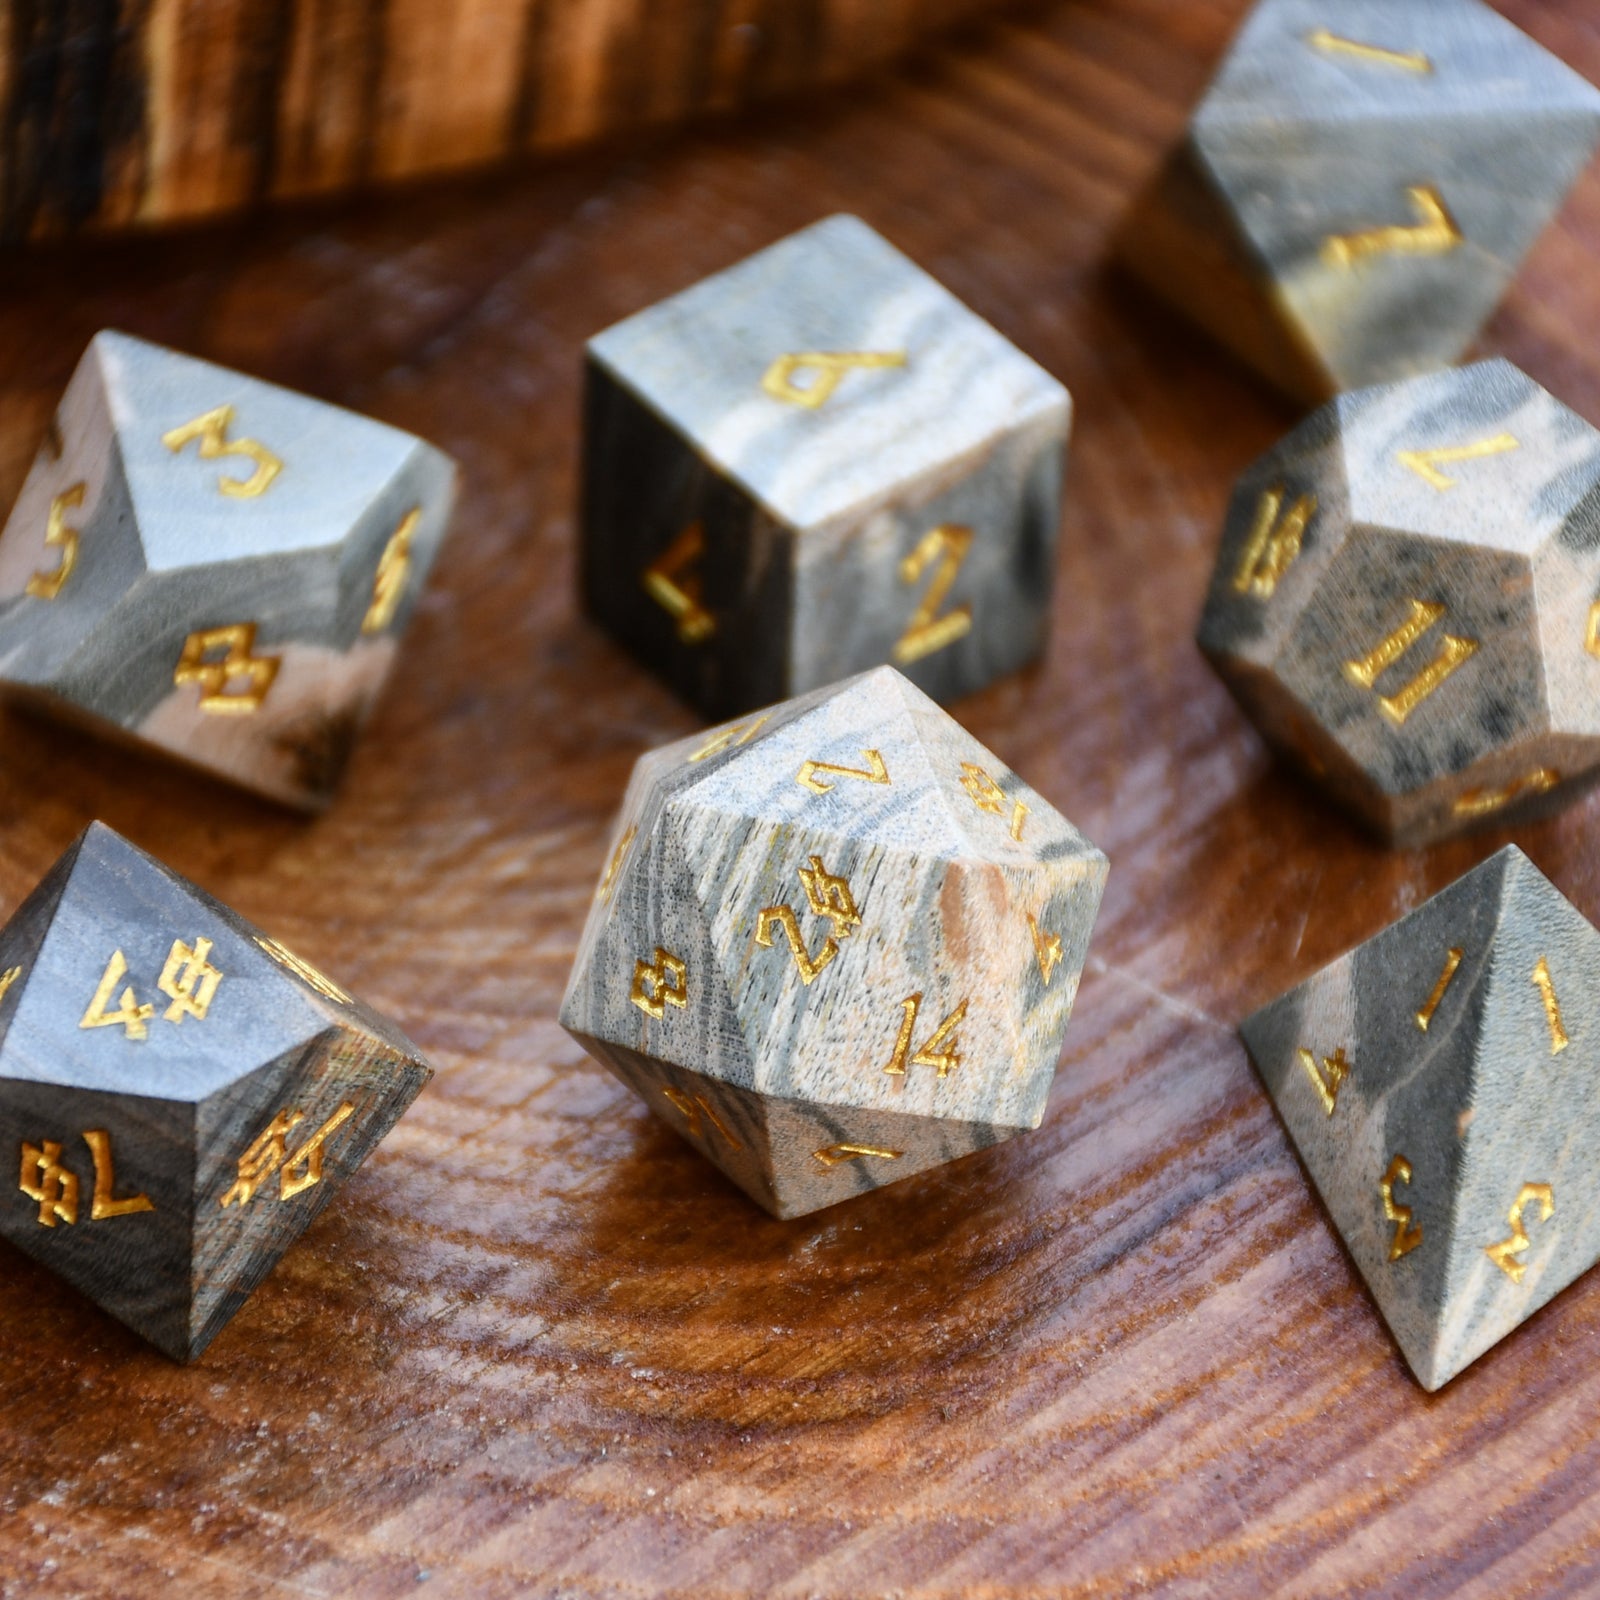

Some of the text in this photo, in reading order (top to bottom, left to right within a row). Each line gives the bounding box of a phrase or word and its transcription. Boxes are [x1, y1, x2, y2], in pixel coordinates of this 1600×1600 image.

[161, 404, 285, 499] 3
[25, 482, 86, 599] 5
[894, 522, 974, 665] 2
[173, 622, 284, 715] 8
[1343, 599, 1479, 725] 11
[796, 748, 892, 795] 2
[754, 855, 862, 986] 20
[78, 936, 224, 1041] 40
[630, 946, 688, 1020] 8
[1414, 947, 1464, 1033] 1
[1531, 955, 1570, 1056] 1
[882, 992, 970, 1079] 14
[1300, 1047, 1352, 1117] 4
[1379, 1152, 1424, 1263] 3
[1484, 1182, 1554, 1285] 3
